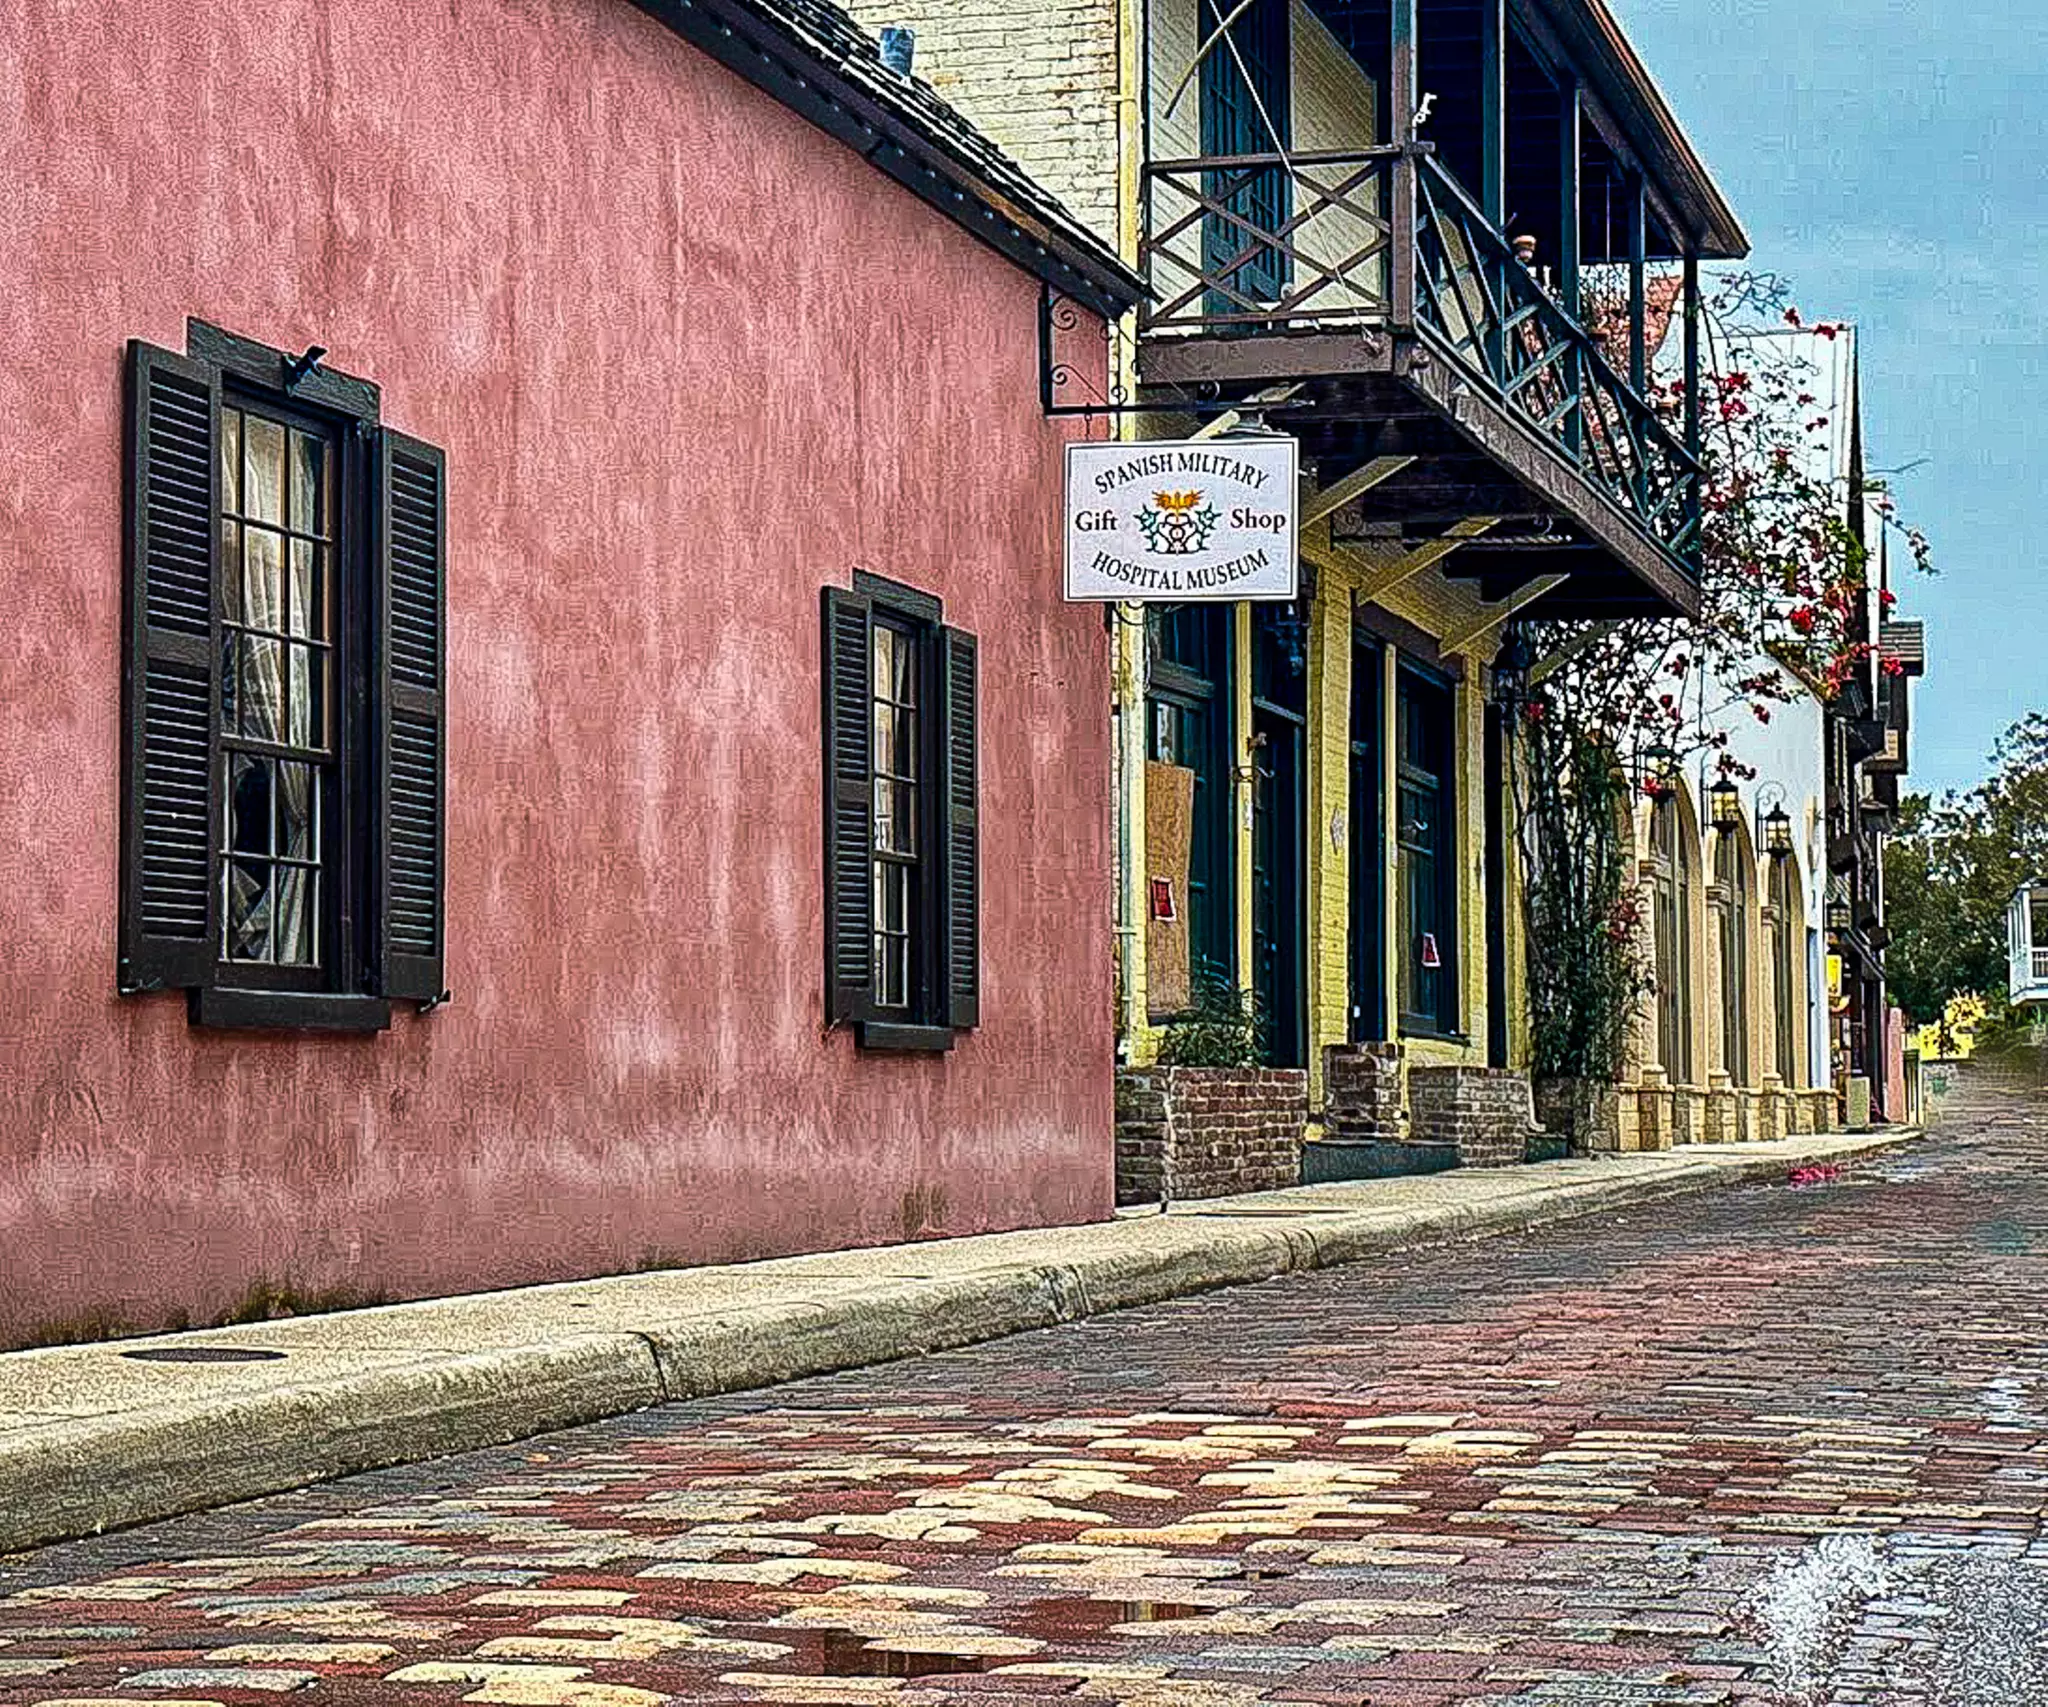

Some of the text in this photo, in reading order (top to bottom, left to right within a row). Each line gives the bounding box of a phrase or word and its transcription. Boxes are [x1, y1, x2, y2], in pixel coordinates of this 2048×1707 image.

[1095, 452, 1269, 494] SPANISH MILITARY
[1075, 507, 1286, 534] Gift Shop
[1091, 548, 1269, 590] HOSPITAL MUSEUM
